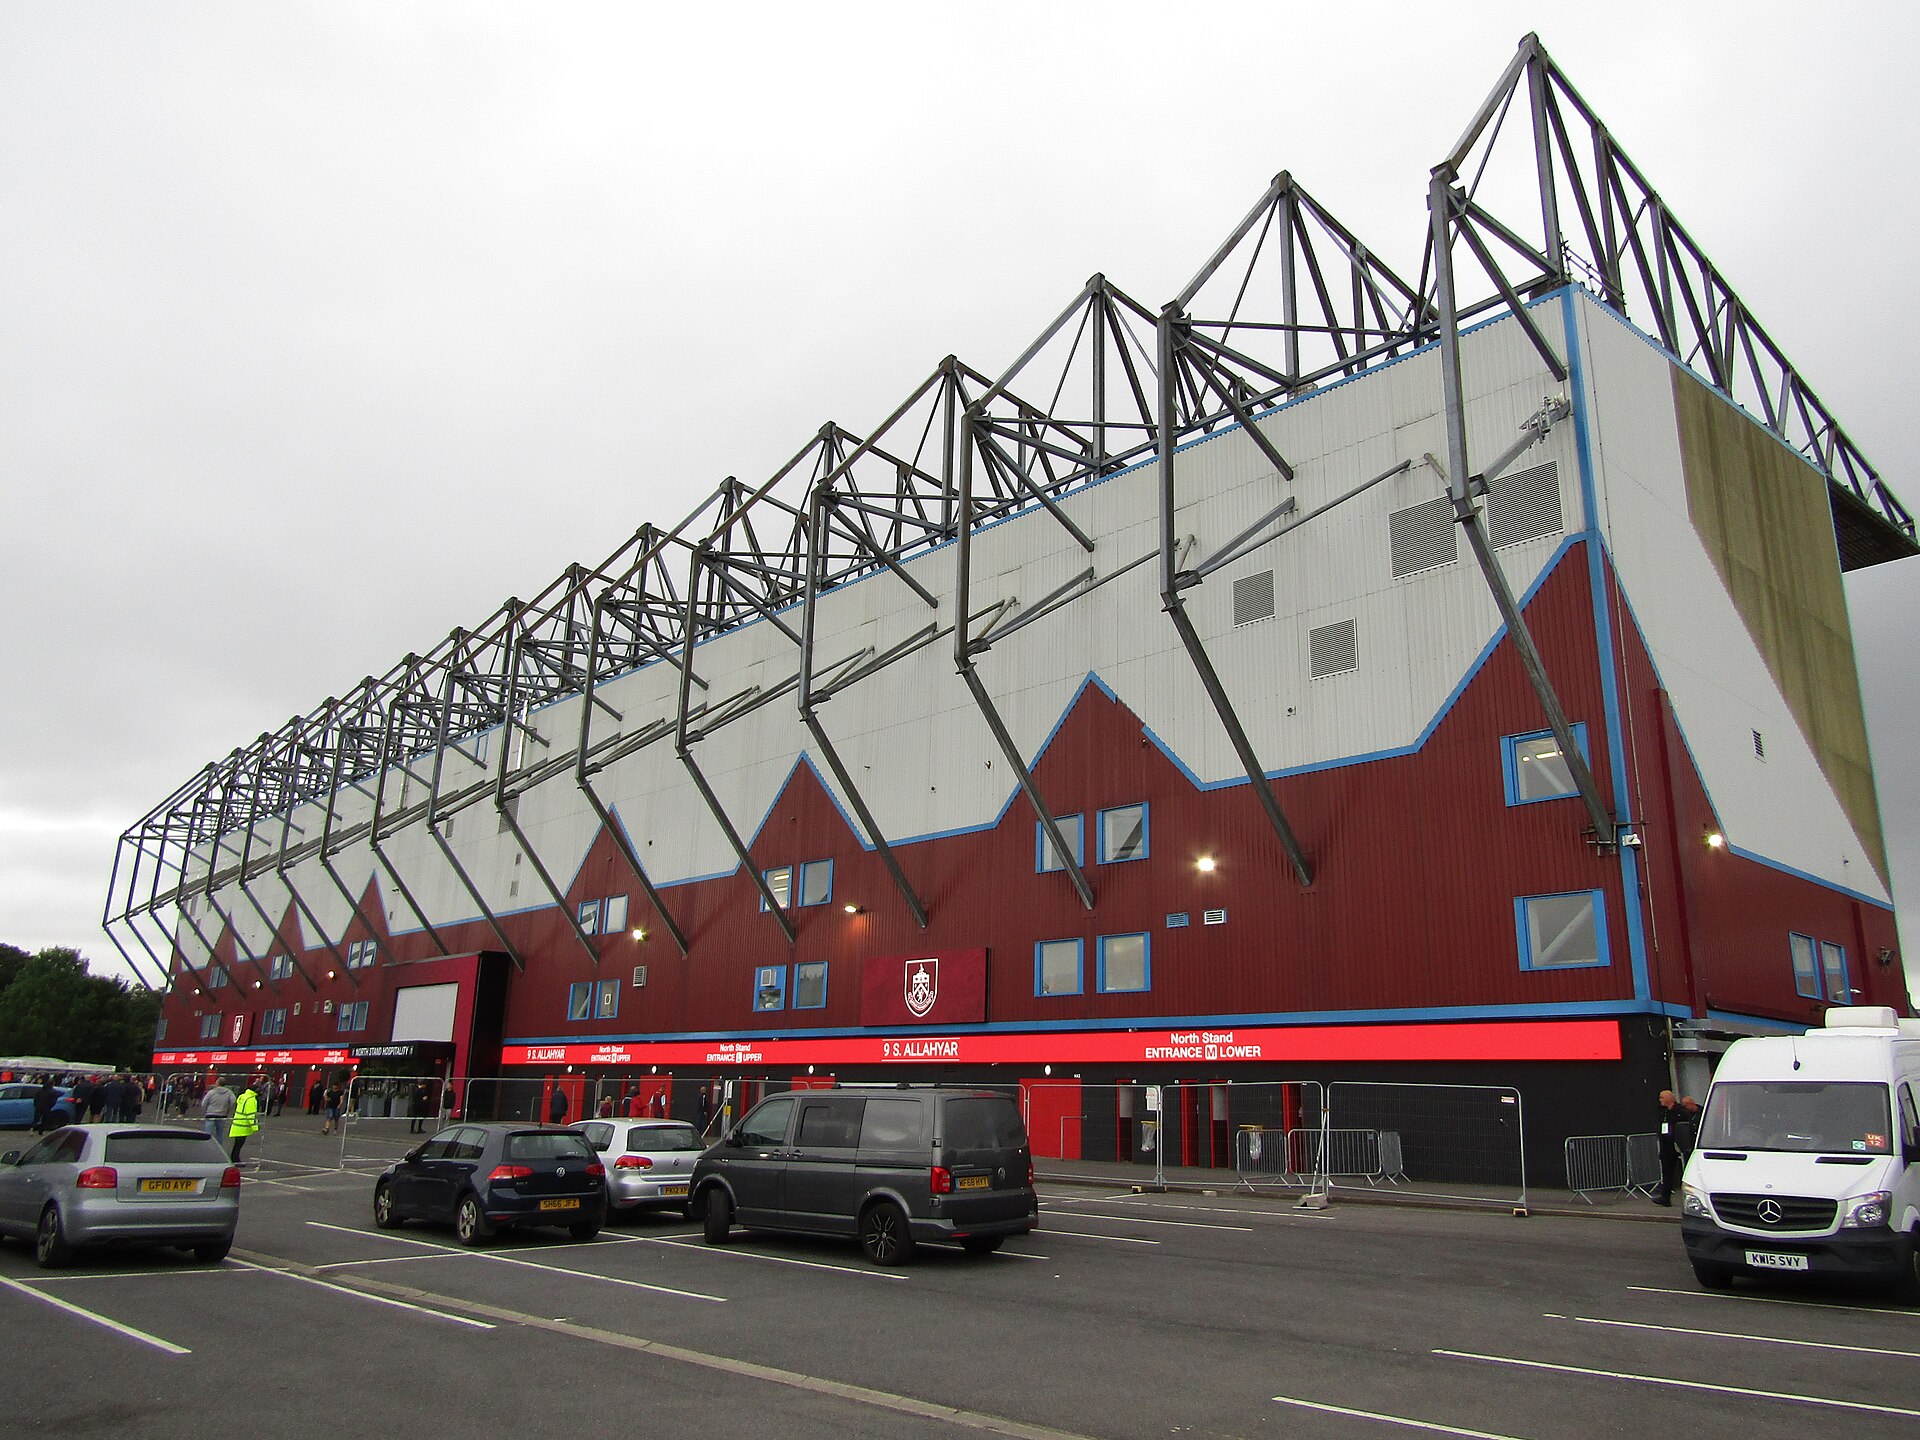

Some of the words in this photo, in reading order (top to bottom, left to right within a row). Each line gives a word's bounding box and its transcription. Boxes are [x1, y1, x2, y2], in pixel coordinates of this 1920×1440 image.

[1170, 1033, 1199, 1044] North
[1202, 1032, 1233, 1043] Stand
[369, 1047, 382, 1056] STAND
[720, 1044, 734, 1052] North
[735, 1043, 751, 1051] Stand
[883, 1043, 890, 1056] 9
[893, 1043, 902, 1056] S.
[903, 1041, 958, 1056] ALLAHYAR
[1145, 1047, 1203, 1059] ENTRANCE
[1219, 1046, 1261, 1057] LOWER
[537, 1049, 565, 1059] ALLAHYAR
[706, 1053, 735, 1062] ENTRANCE
[743, 1053, 762, 1062] UPPER
[173, 1181, 192, 1190] AYP
[1752, 1254, 1776, 1265] KW15
[1779, 1256, 1800, 1267] SVY
